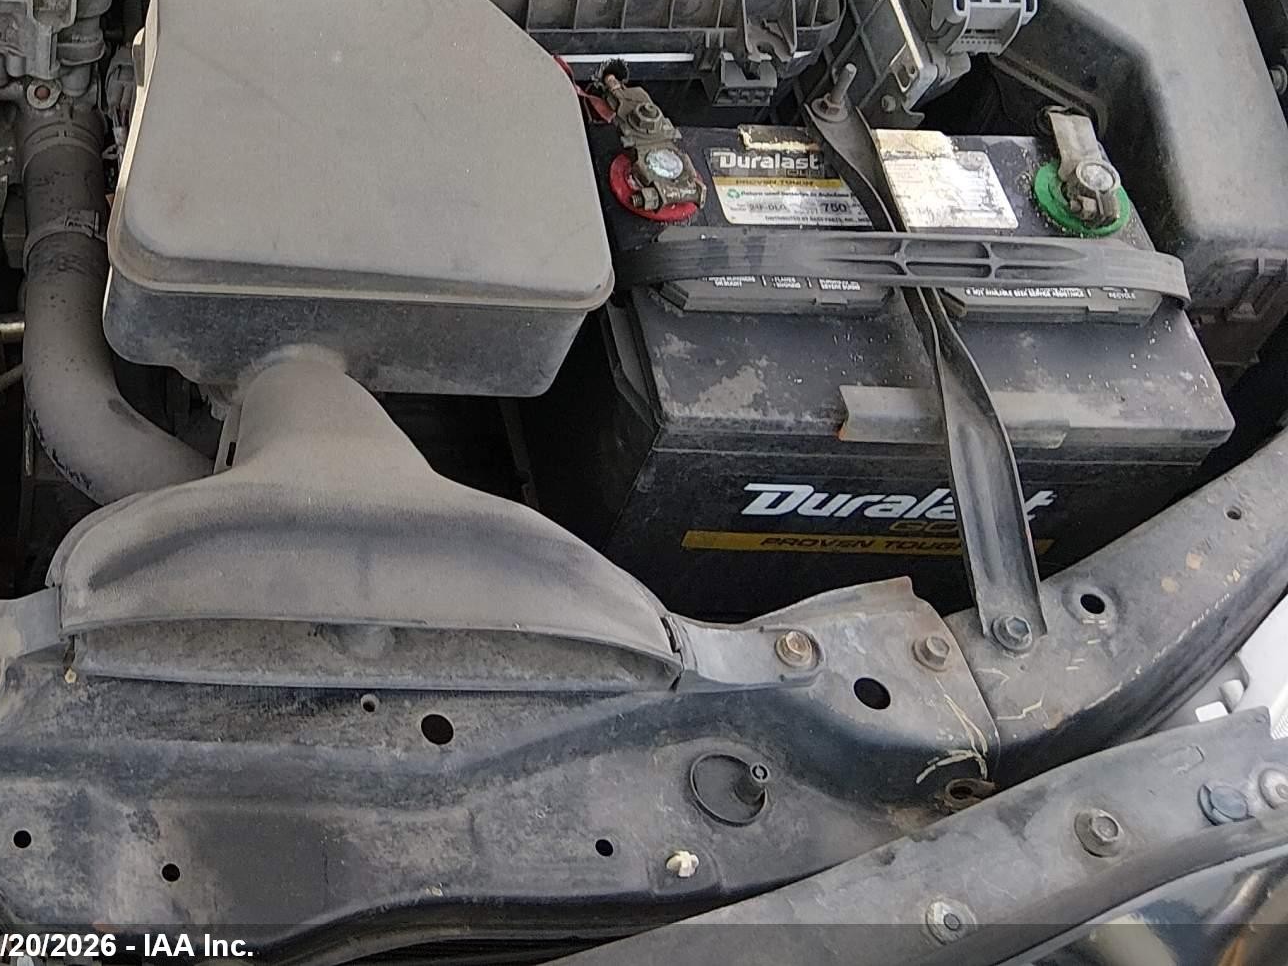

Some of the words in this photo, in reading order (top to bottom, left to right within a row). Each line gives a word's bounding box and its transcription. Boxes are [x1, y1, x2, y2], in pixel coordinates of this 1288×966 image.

[712, 151, 820, 170] Duralast
[741, 483, 1057, 522] Duralat
[760, 537, 875, 549] PROVEN
